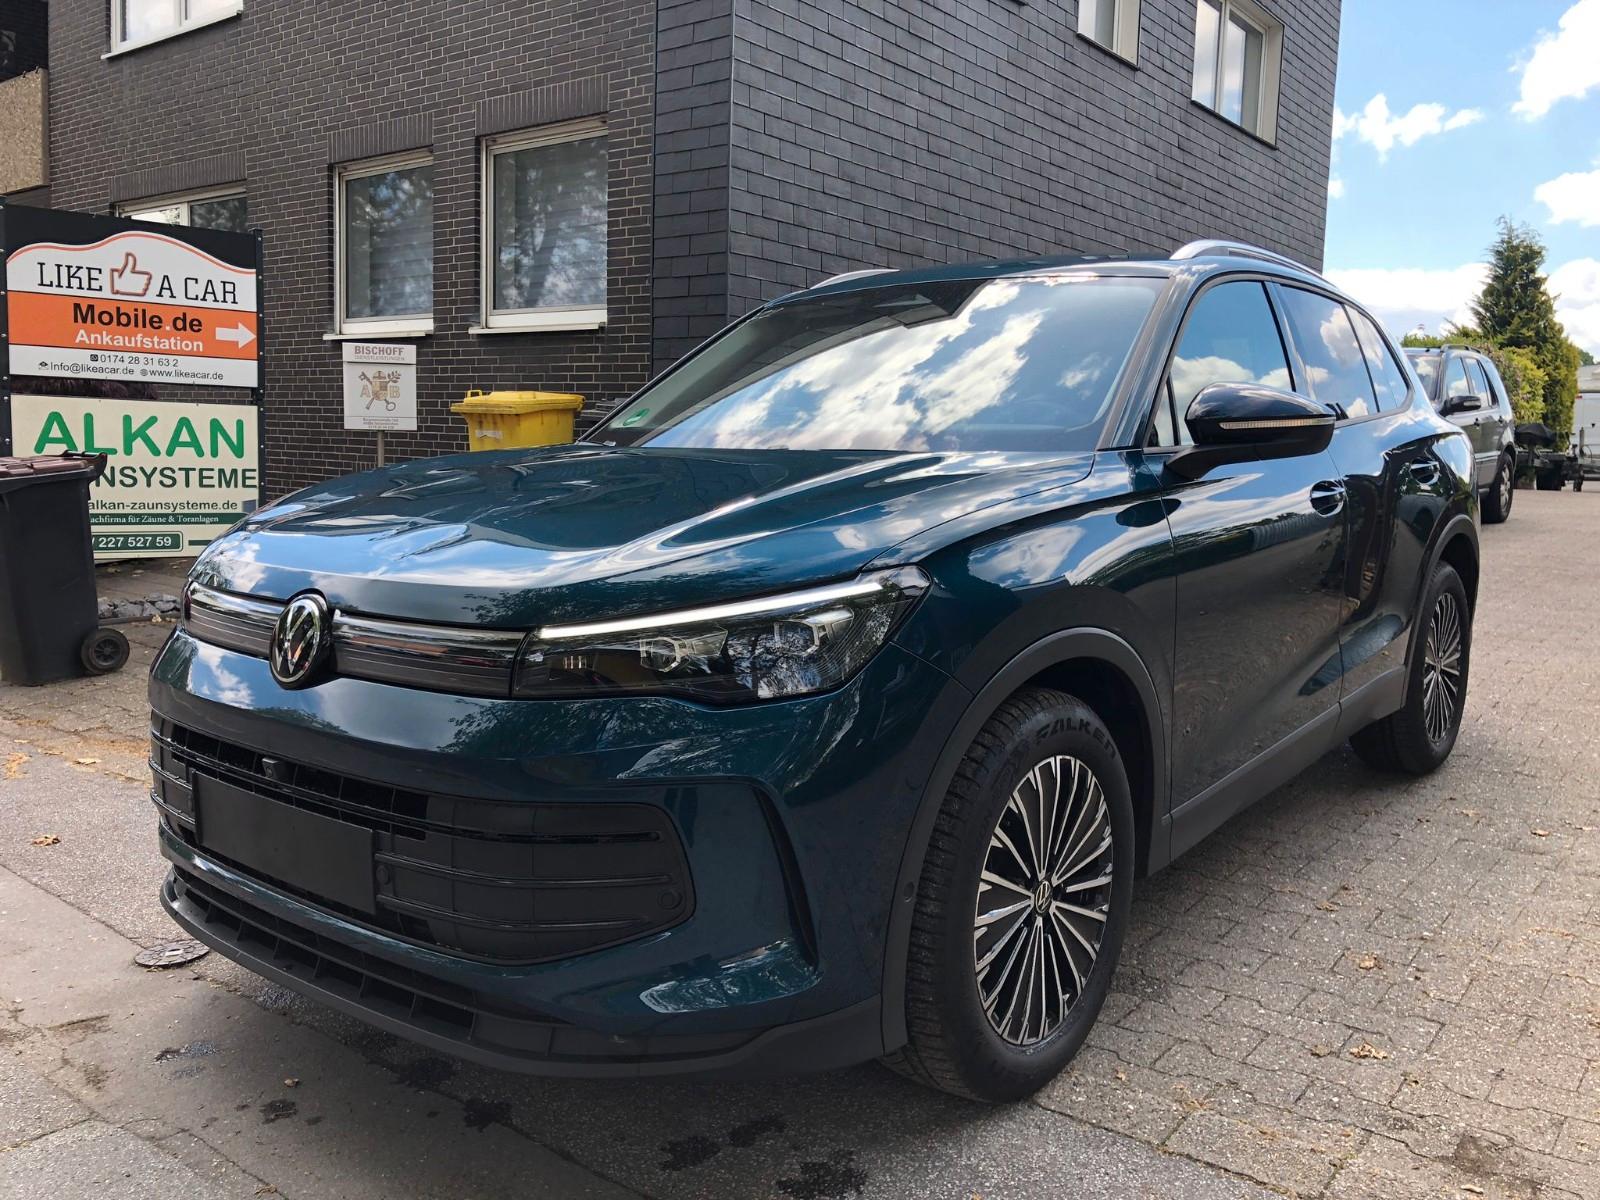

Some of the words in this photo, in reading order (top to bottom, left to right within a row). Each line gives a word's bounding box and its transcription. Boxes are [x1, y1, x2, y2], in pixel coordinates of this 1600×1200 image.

[36, 262, 103, 292] LIKE
[156, 274, 177, 299] A
[184, 277, 239, 305] CAR
[72, 302, 203, 333] Mobile.de
[75, 329, 204, 353] Ankaufstation
[354, 345, 405, 356] BISCHOFF
[100, 353, 125, 365] 0174
[128, 355, 140, 365] 28
[143, 356, 155, 366] 31
[149, 368, 224, 381] www.likeacar.de
[33, 411, 245, 459] ALKAN
[94, 466, 258, 489] NSYSTEME
[88, 499, 238, 513] alkan-zaunsysteme.de
[89, 515, 127, 524] achfirma
[127, 515, 141, 524] für
[141, 515, 167, 524] Zäune
[168, 515, 176, 524] &
[176, 515, 219, 525] Toranlagen
[98, 536, 124, 548] 227
[127, 536, 152, 547] 527
[155, 535, 172, 547] 59
